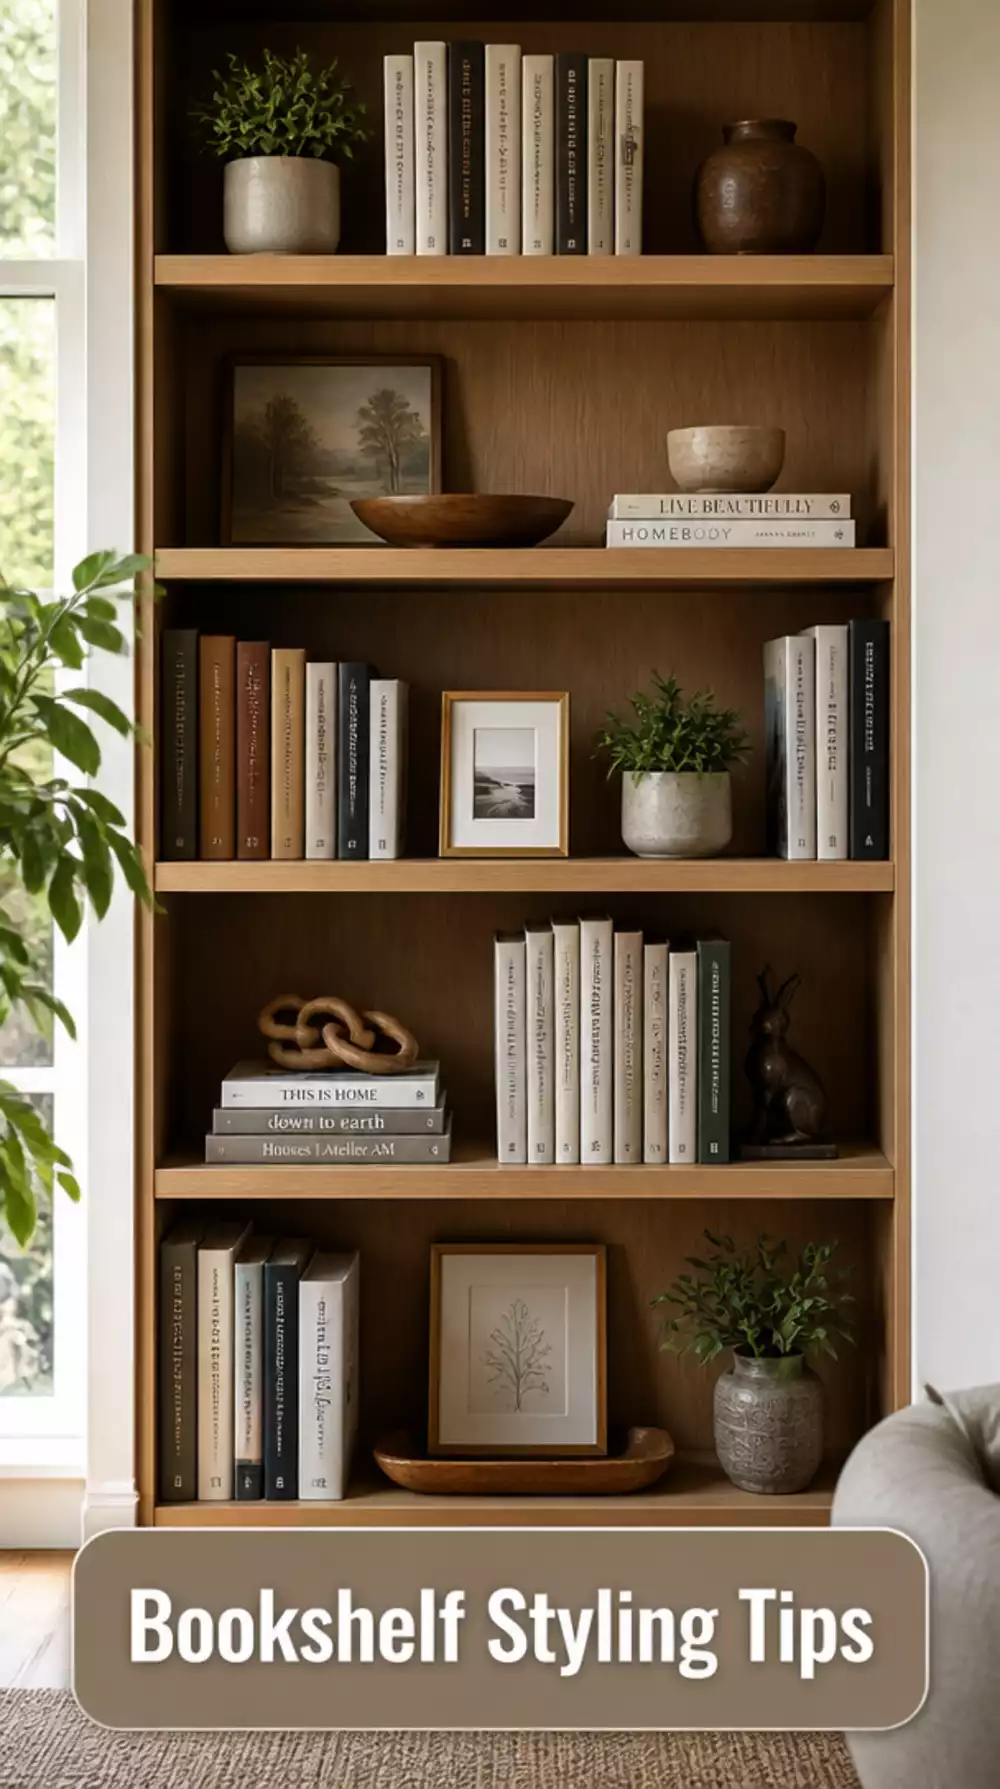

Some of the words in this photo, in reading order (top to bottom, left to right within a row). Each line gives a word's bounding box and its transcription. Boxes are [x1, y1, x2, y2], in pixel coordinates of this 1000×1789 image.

[659, 499, 698, 514] LIVE
[702, 499, 815, 514] BEAUTIFULLY
[622, 527, 733, 541] HOMEBODY
[280, 1089, 315, 1101] THIS
[318, 1089, 331, 1101] IS
[335, 1089, 378, 1101] HOME
[268, 1114, 313, 1129] down
[319, 1114, 335, 1129] to
[340, 1114, 385, 1129] earth
[371, 1142, 395, 1157] AM
